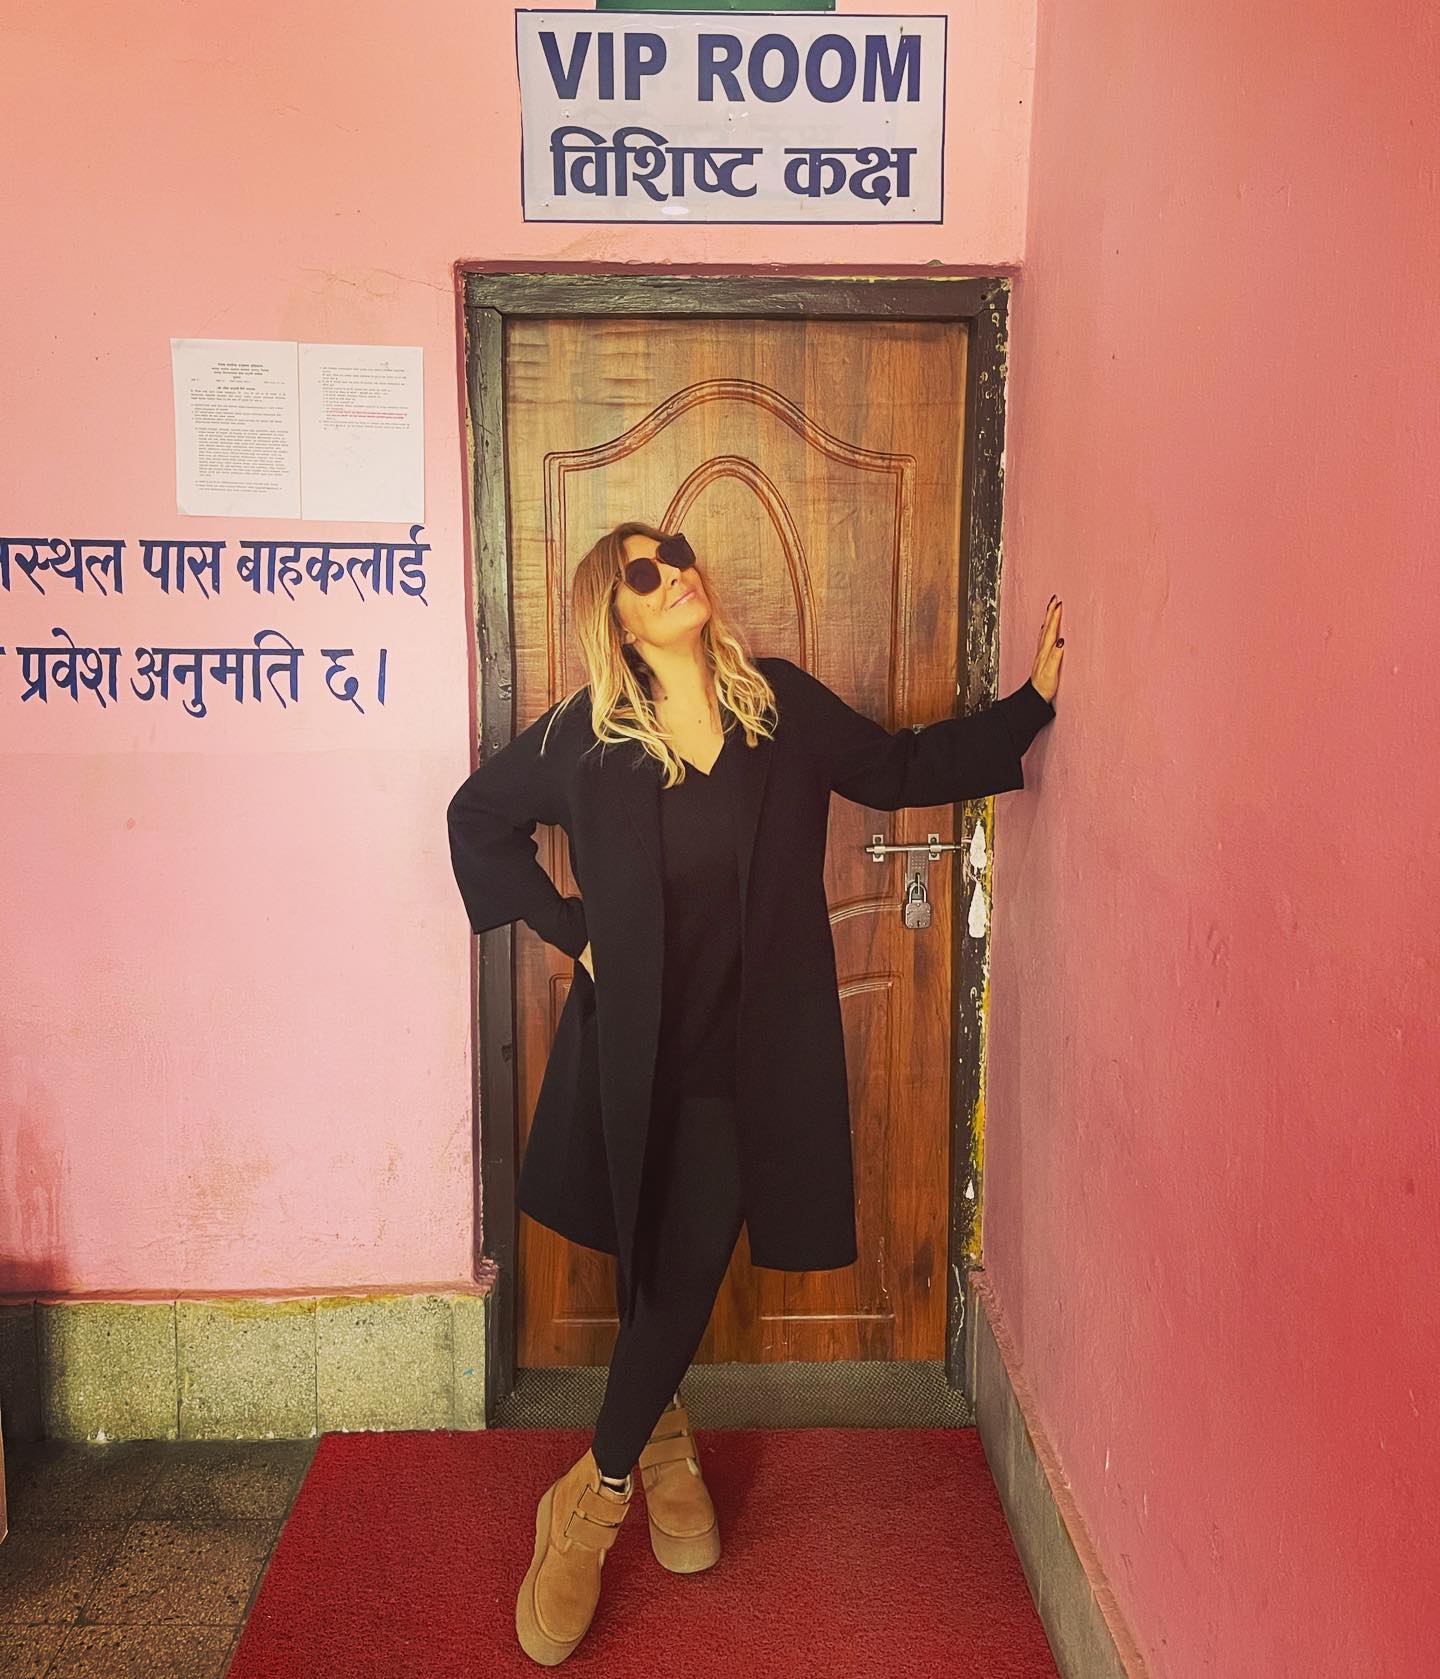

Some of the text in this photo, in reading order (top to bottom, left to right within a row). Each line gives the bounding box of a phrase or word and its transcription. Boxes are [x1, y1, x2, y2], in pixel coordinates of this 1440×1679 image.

[538, 31, 922, 104] VIP ROOM
[549, 125, 918, 207] विशिष्ट कक्ष
[138, 539, 227, 599] पास
[236, 524, 432, 607] बाहकलाई
[16, 627, 123, 709] प्रवेश
[130, 629, 305, 719] अनुमति
